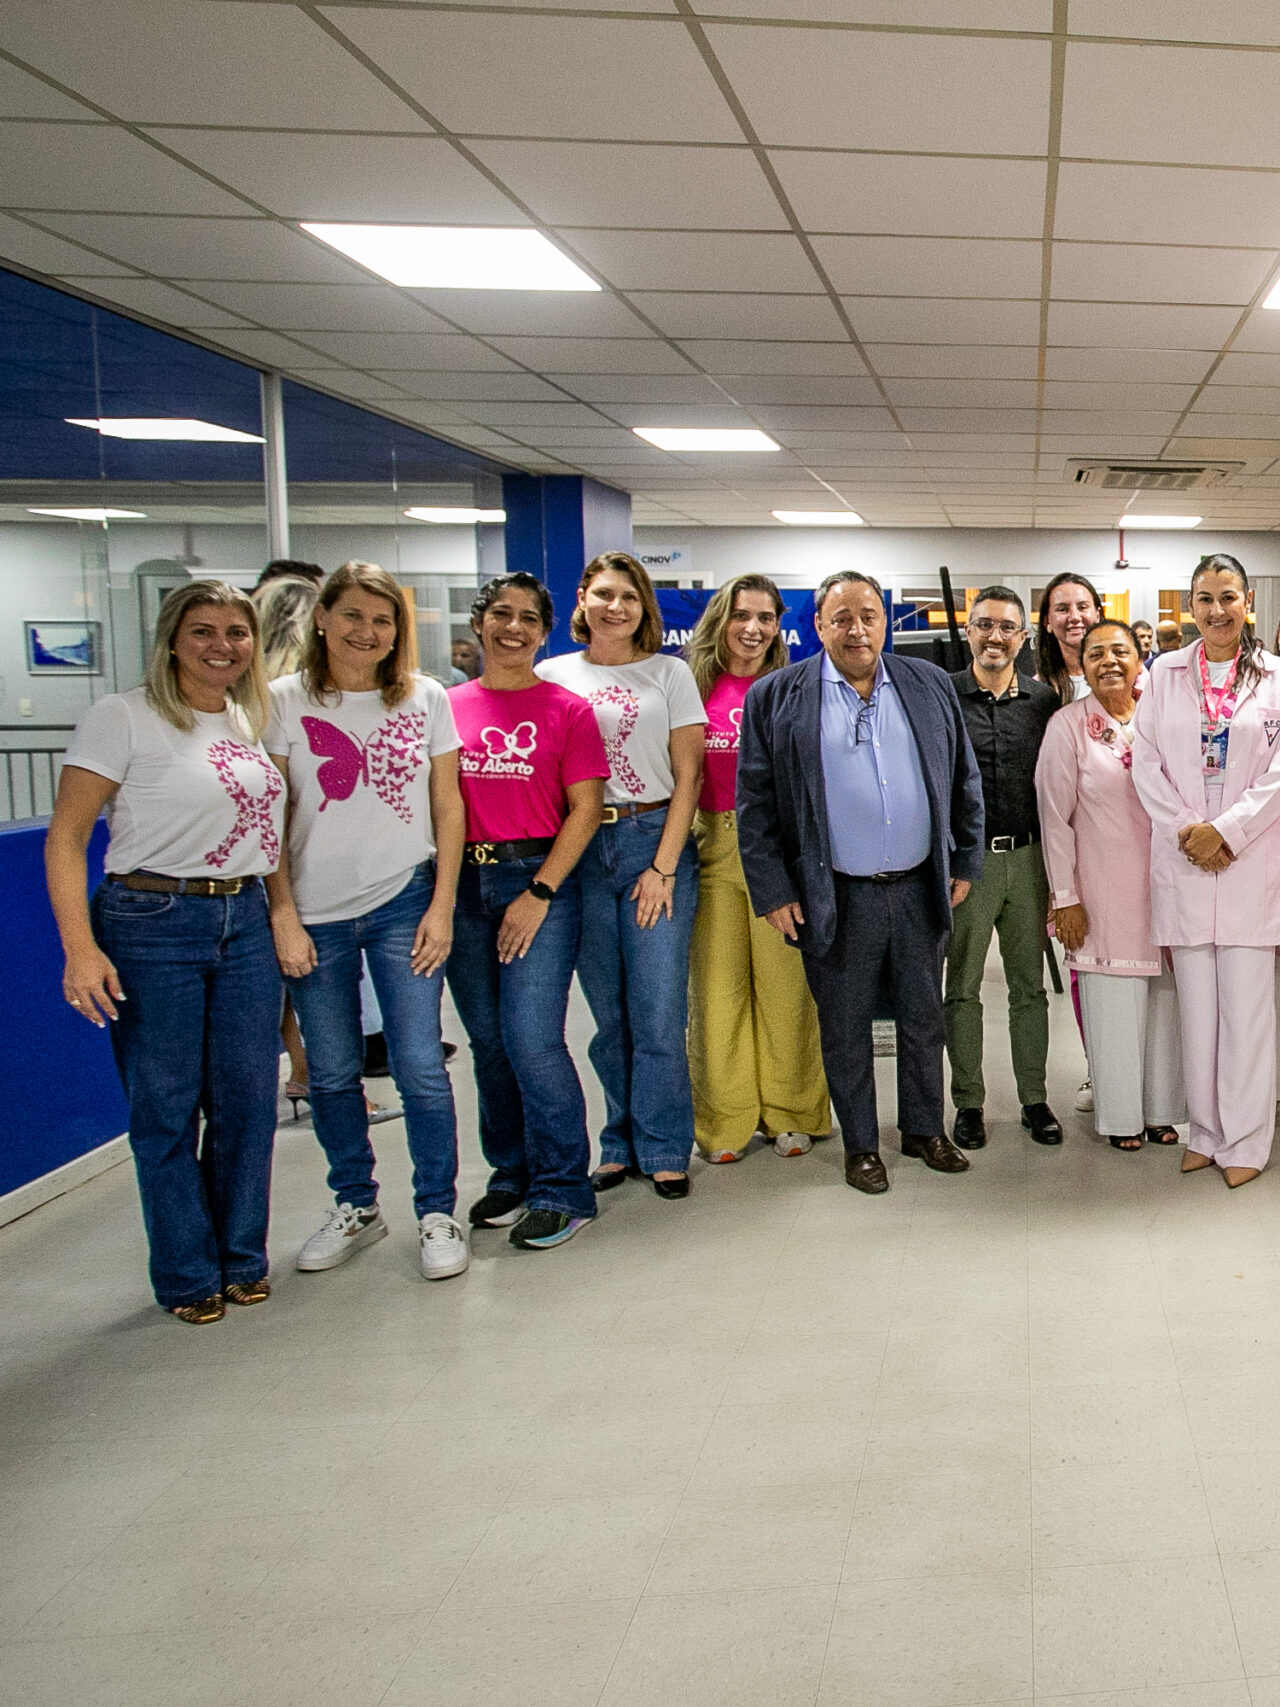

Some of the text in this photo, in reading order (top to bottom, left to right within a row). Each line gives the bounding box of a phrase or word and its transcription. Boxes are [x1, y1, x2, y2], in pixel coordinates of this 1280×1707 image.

[641, 555, 671, 564] CINOV
[1263, 720, 1280, 728] RFC
[481, 757, 535, 776] Aberto
